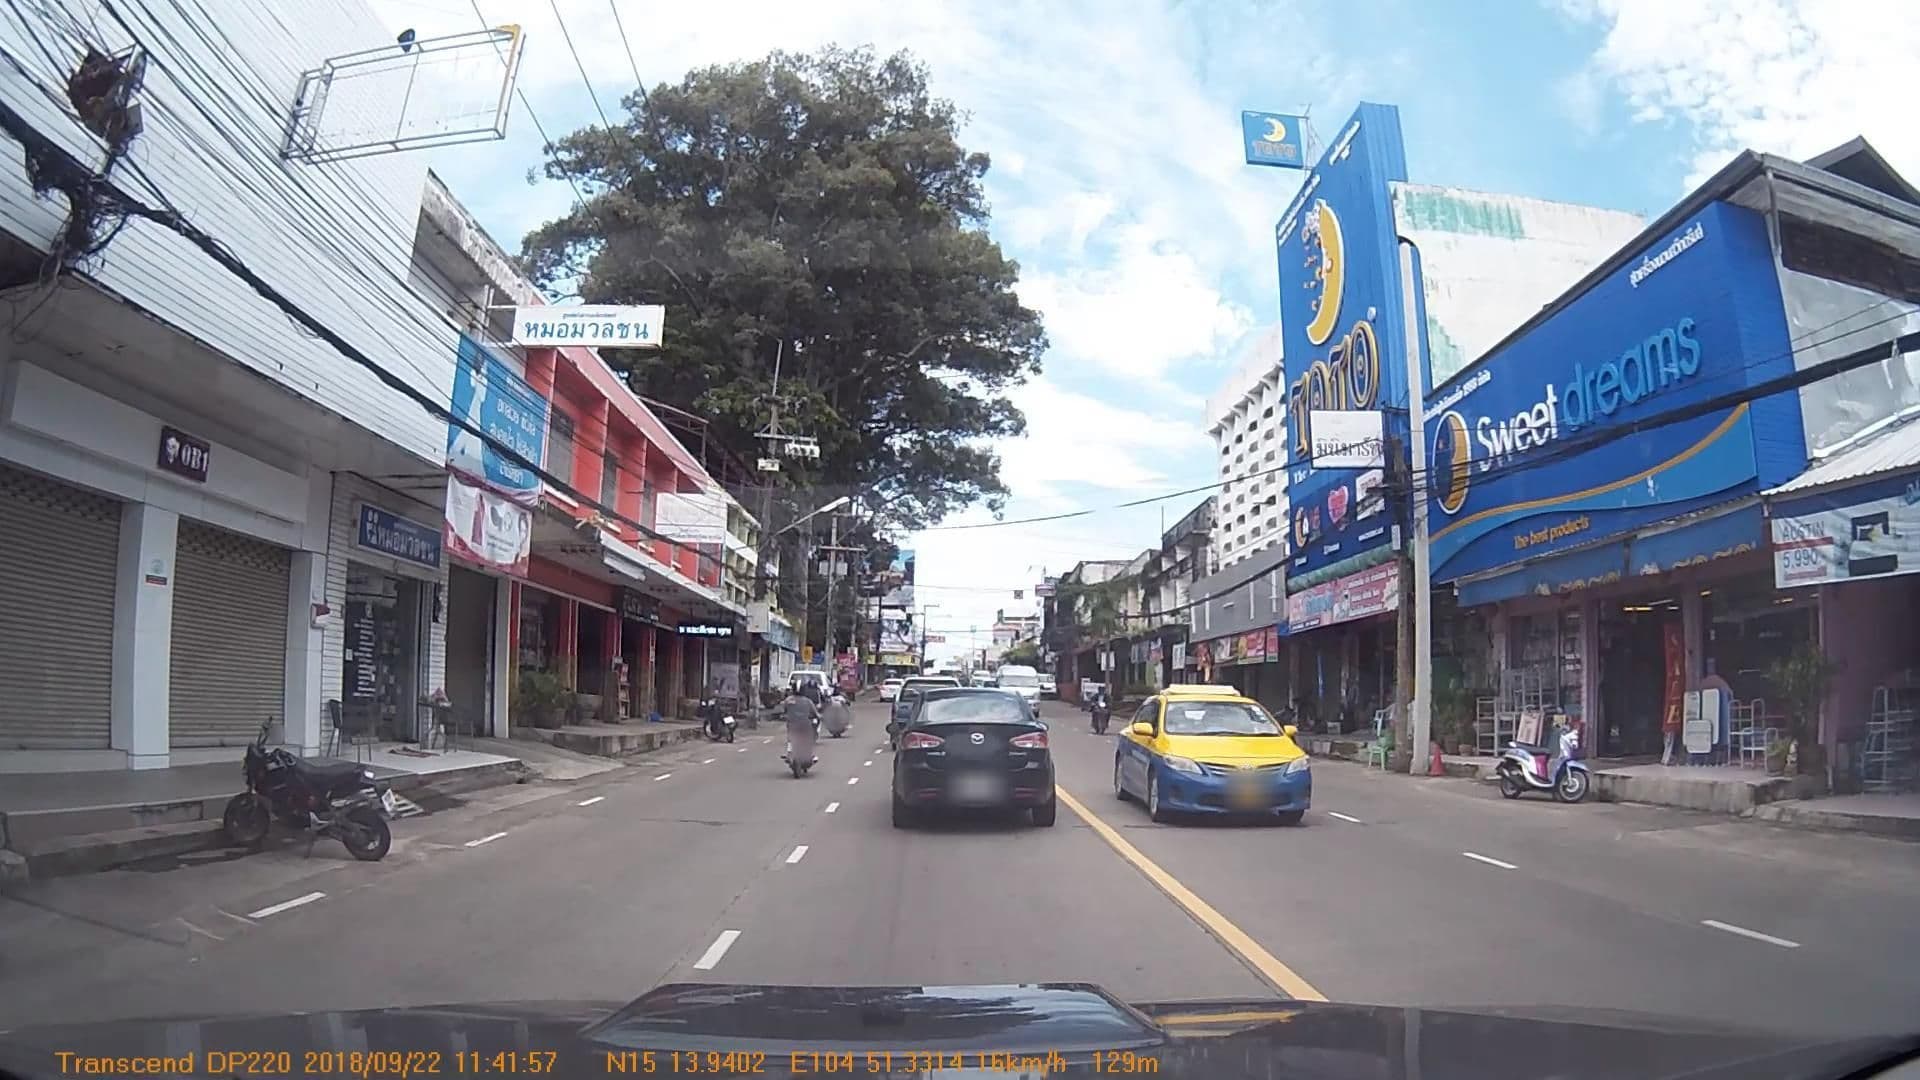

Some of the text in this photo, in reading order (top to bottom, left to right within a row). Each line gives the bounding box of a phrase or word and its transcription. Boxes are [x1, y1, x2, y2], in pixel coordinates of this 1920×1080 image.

[525, 321, 649, 340] หมอมวลชน
[1477, 317, 1701, 472] Sweet dreams
[1550, 515, 1590, 544] products
